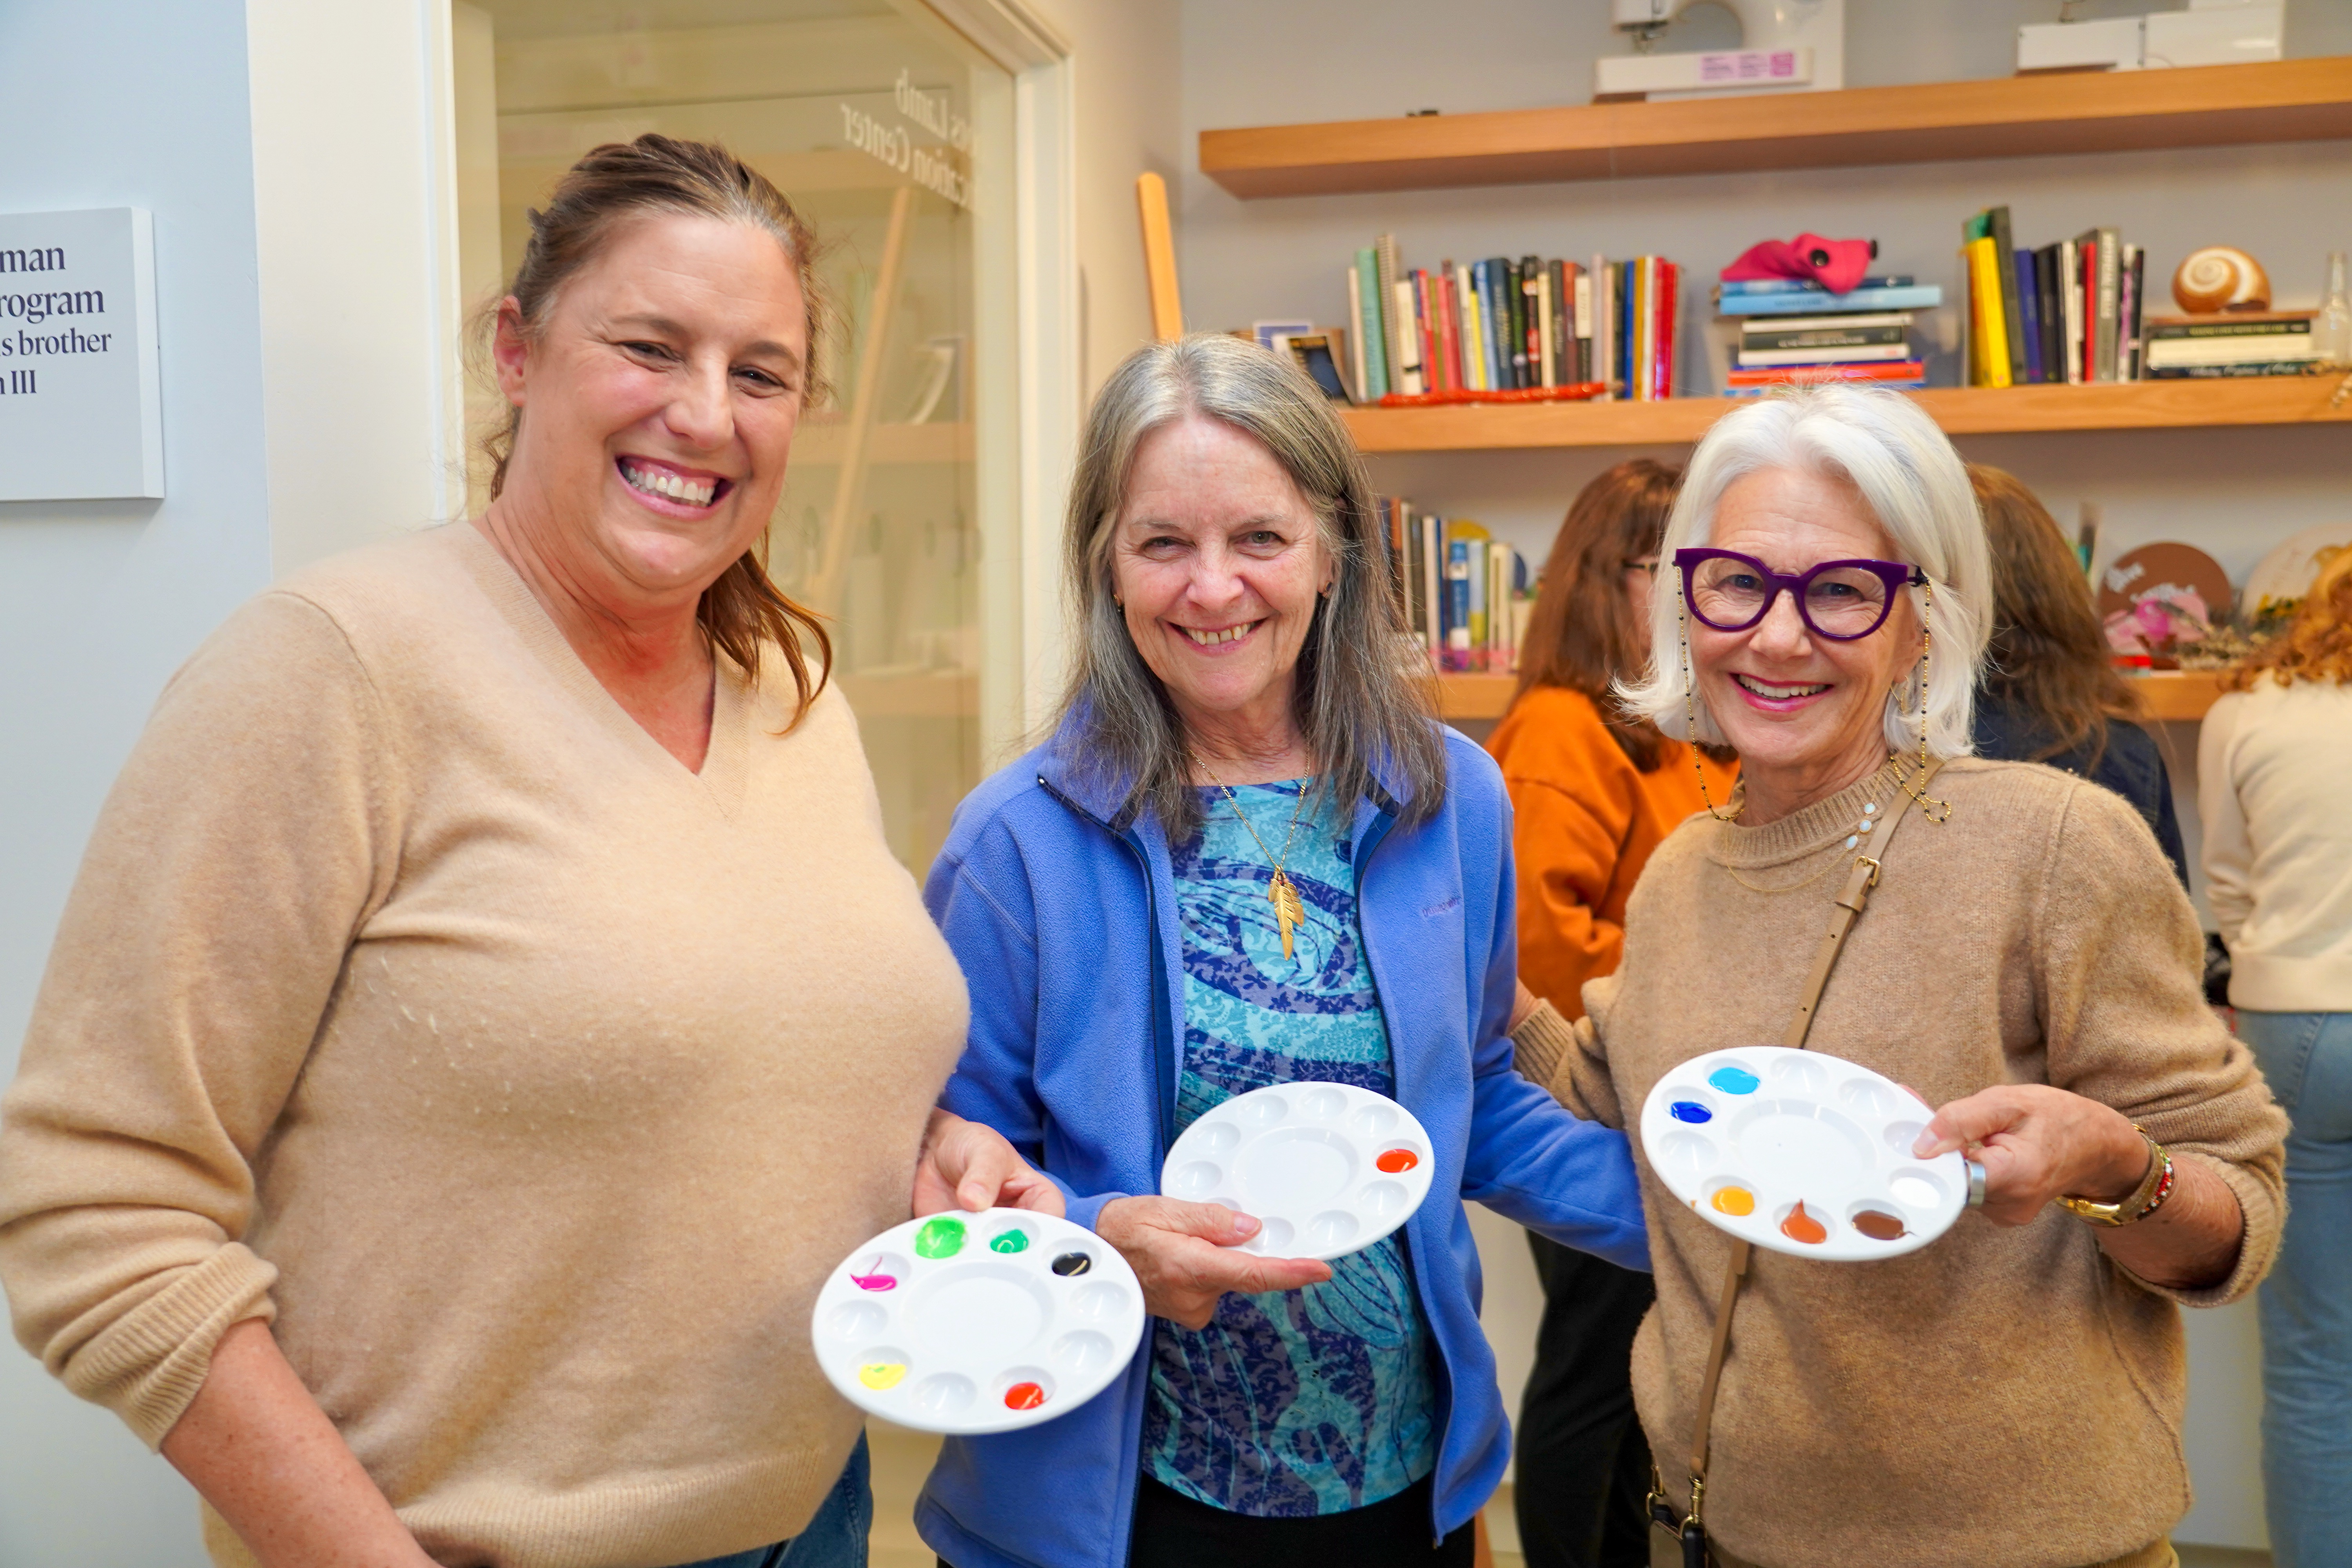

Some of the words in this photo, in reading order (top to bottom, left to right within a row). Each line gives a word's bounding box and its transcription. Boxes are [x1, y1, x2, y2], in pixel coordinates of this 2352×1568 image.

[0, 247, 66, 273] man
[18, 327, 112, 356] brother
[11, 369, 37, 394] III
